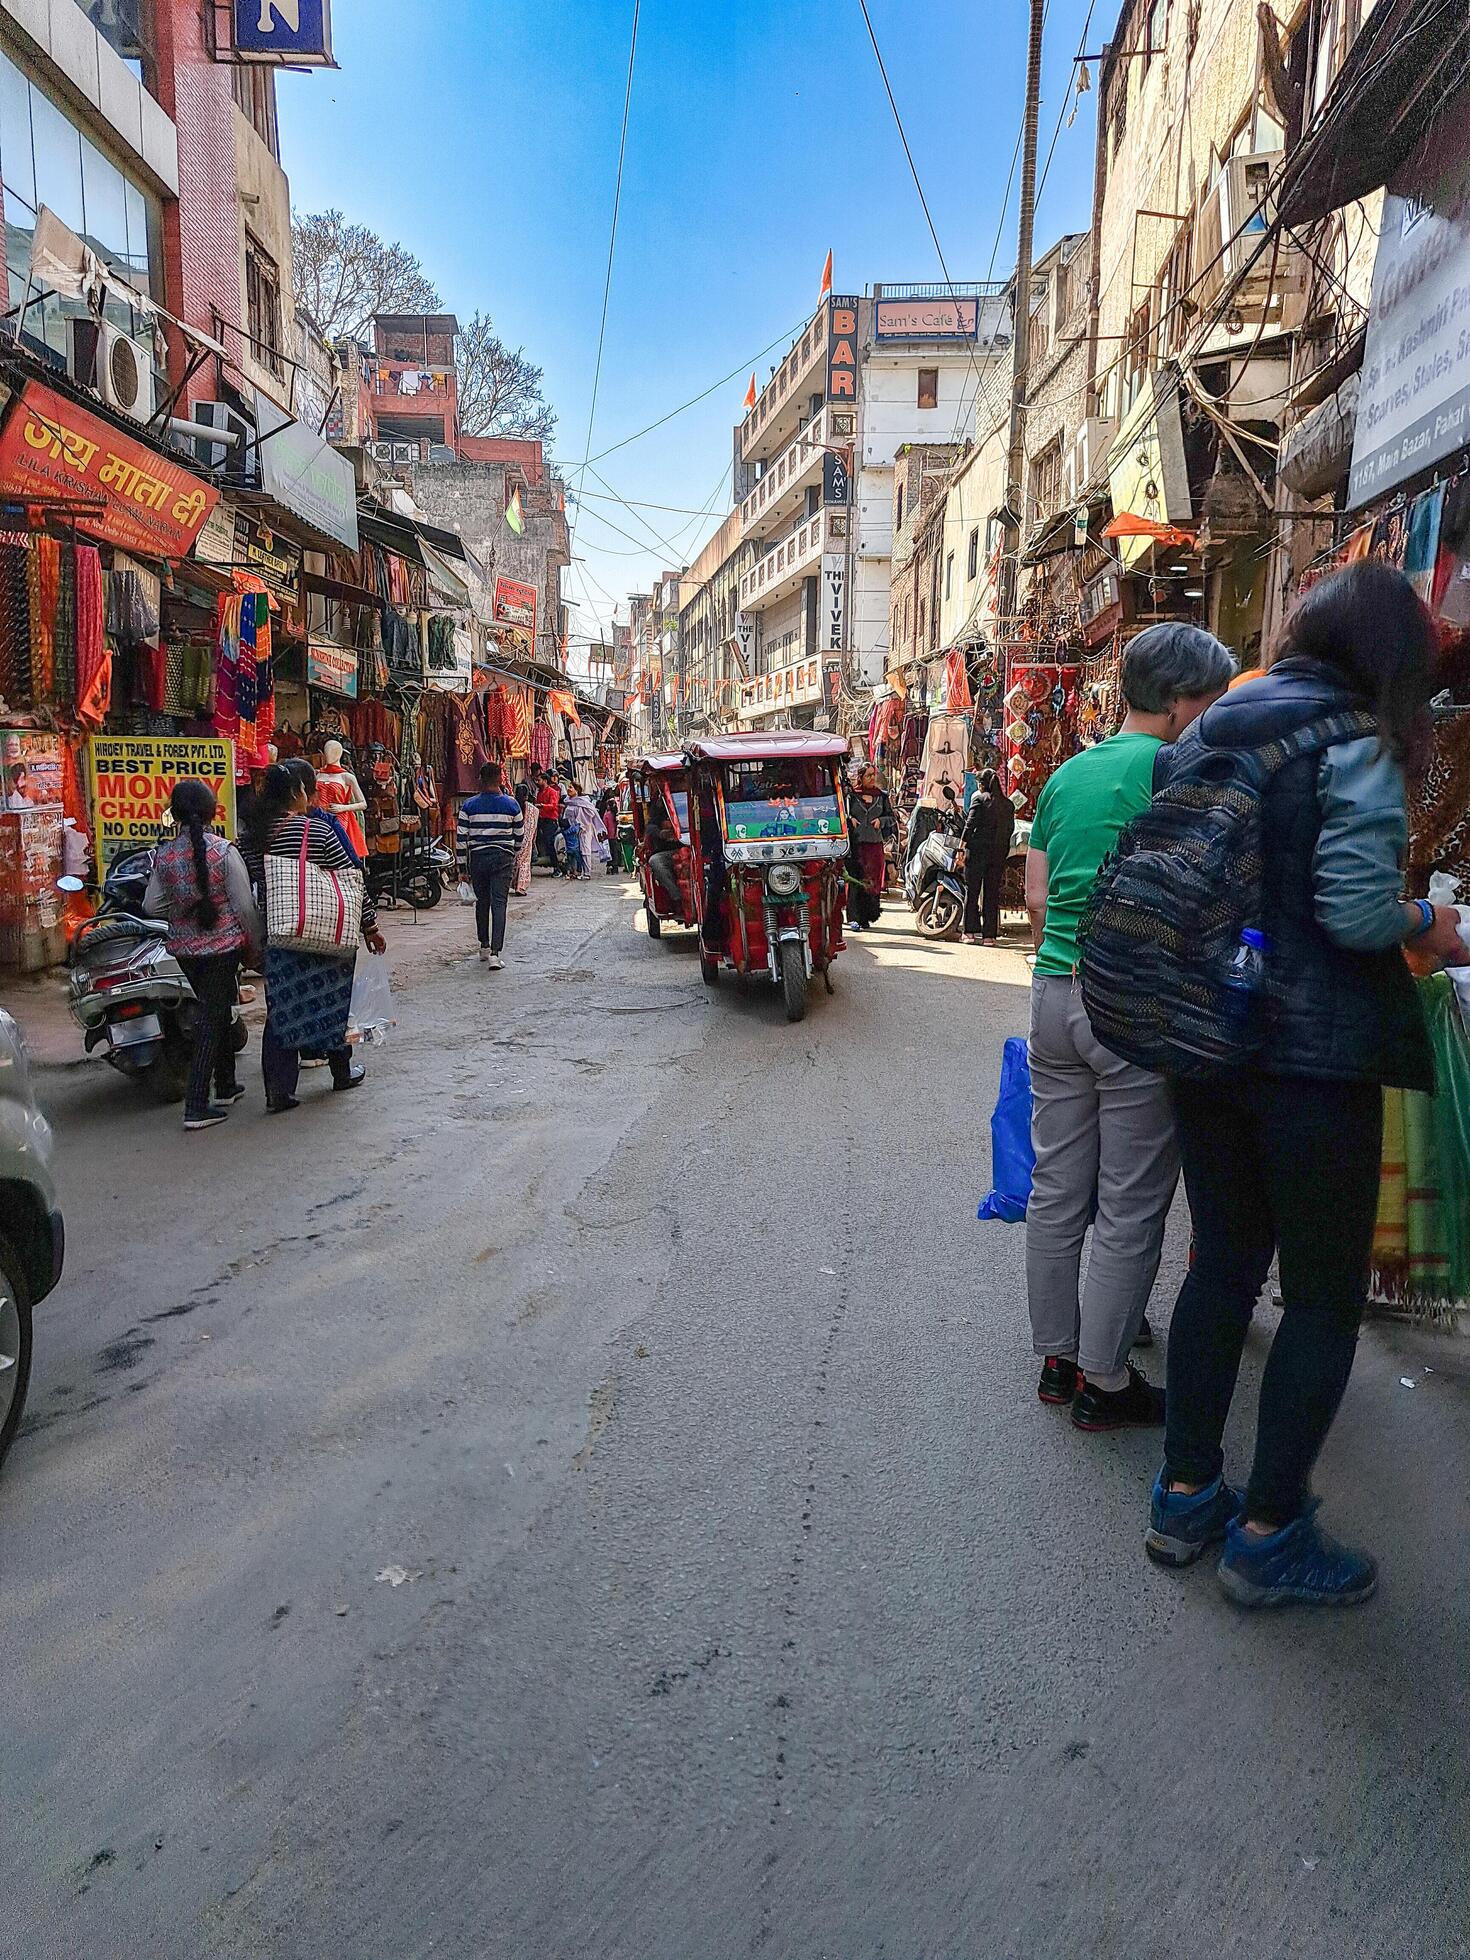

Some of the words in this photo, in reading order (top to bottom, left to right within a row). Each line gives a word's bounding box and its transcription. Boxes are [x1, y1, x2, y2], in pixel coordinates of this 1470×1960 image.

[831, 297, 857, 308] SAM'S
[880, 314, 917, 327] Sam's
[922, 313, 953, 327] Café
[831, 310, 856, 395] BAR
[16, 453, 50, 477] LILA
[23, 410, 100, 474] जय
[99, 452, 174, 511] माता
[171, 487, 209, 529] दी
[1377, 448, 1399, 476] Main
[824, 570, 844, 580] TH
[830, 583, 842, 649] VIVEK
[737, 625, 753, 633] THE
[125, 743, 154, 758] TRAVEL
[155, 743, 162, 758] &
[163, 744, 189, 758] FOREX
[191, 744, 208, 759] PVT.
[209, 745, 226, 759] LTD.
[95, 759, 154, 774] BEST
[161, 760, 227, 776] PRICE
[99, 801, 227, 821] CHANR
[103, 822, 124, 836] NO
